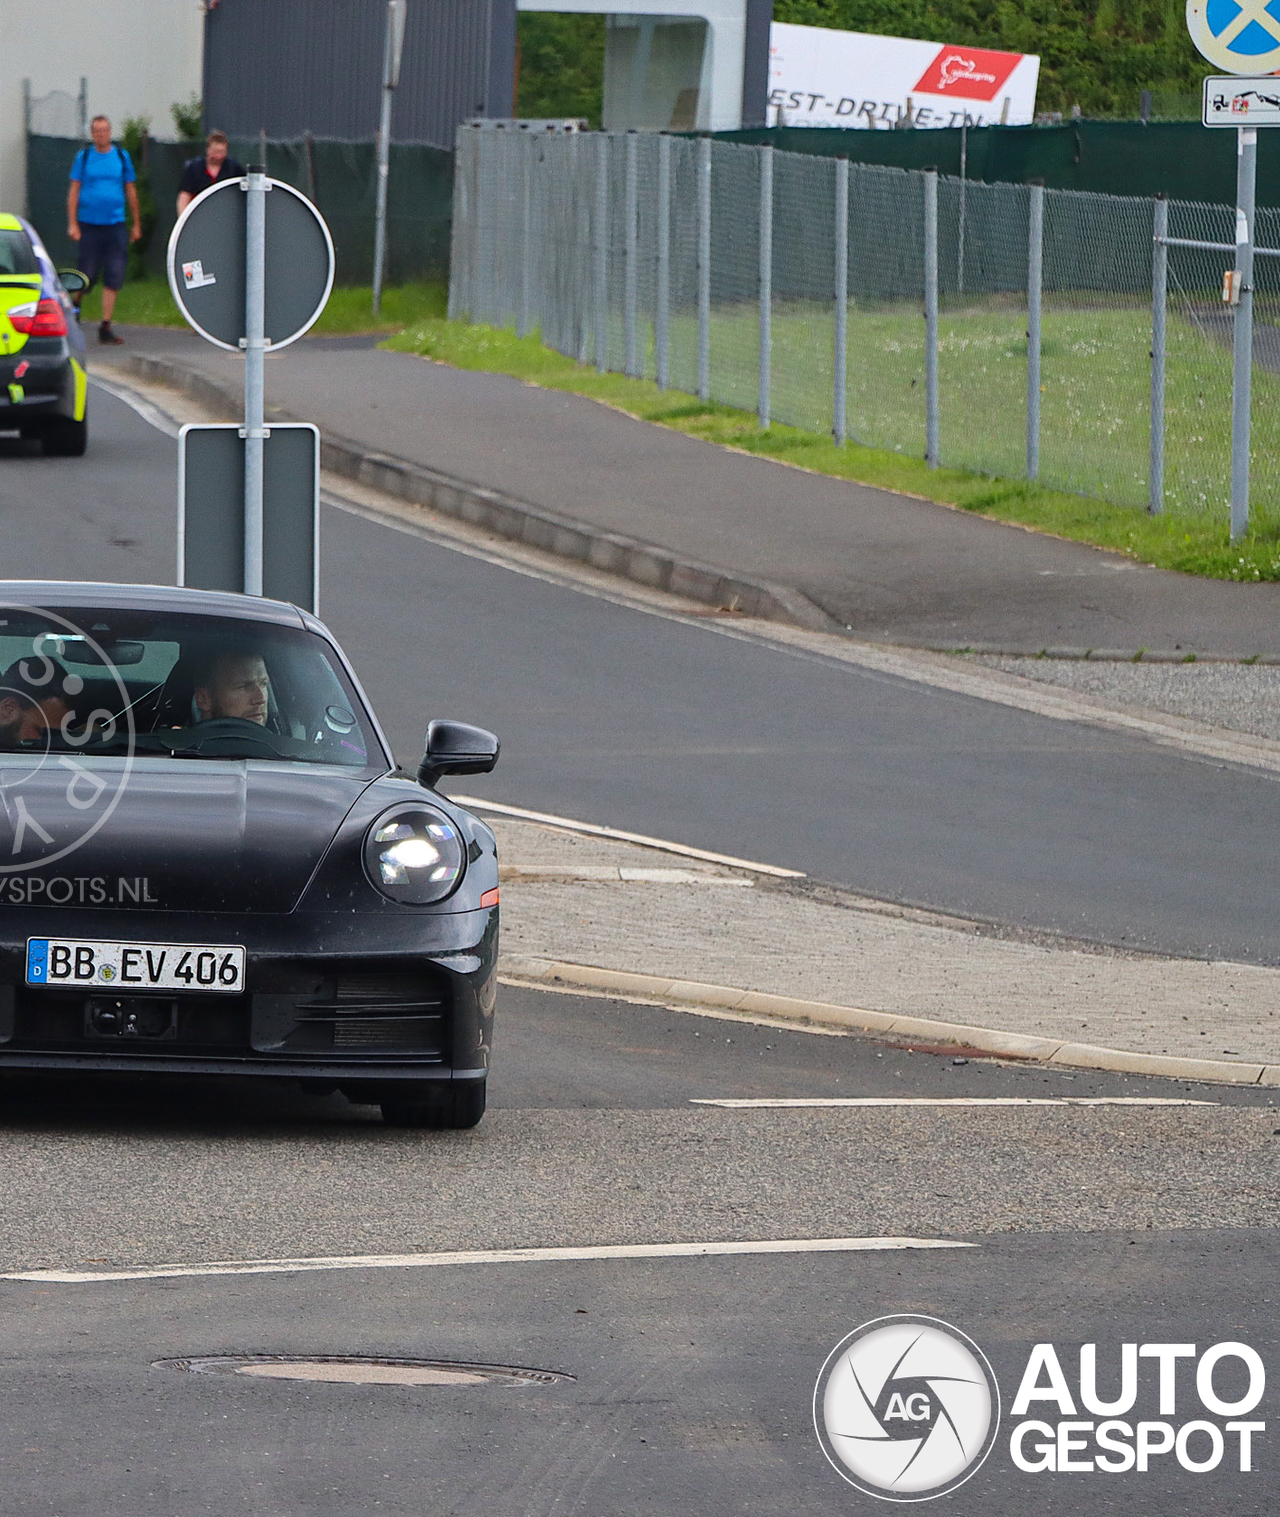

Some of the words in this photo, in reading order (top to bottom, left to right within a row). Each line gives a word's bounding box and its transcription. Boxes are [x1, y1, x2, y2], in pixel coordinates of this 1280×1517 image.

[50, 945, 96, 980] BB
[121, 948, 167, 983] EV
[173, 951, 239, 986] 406
